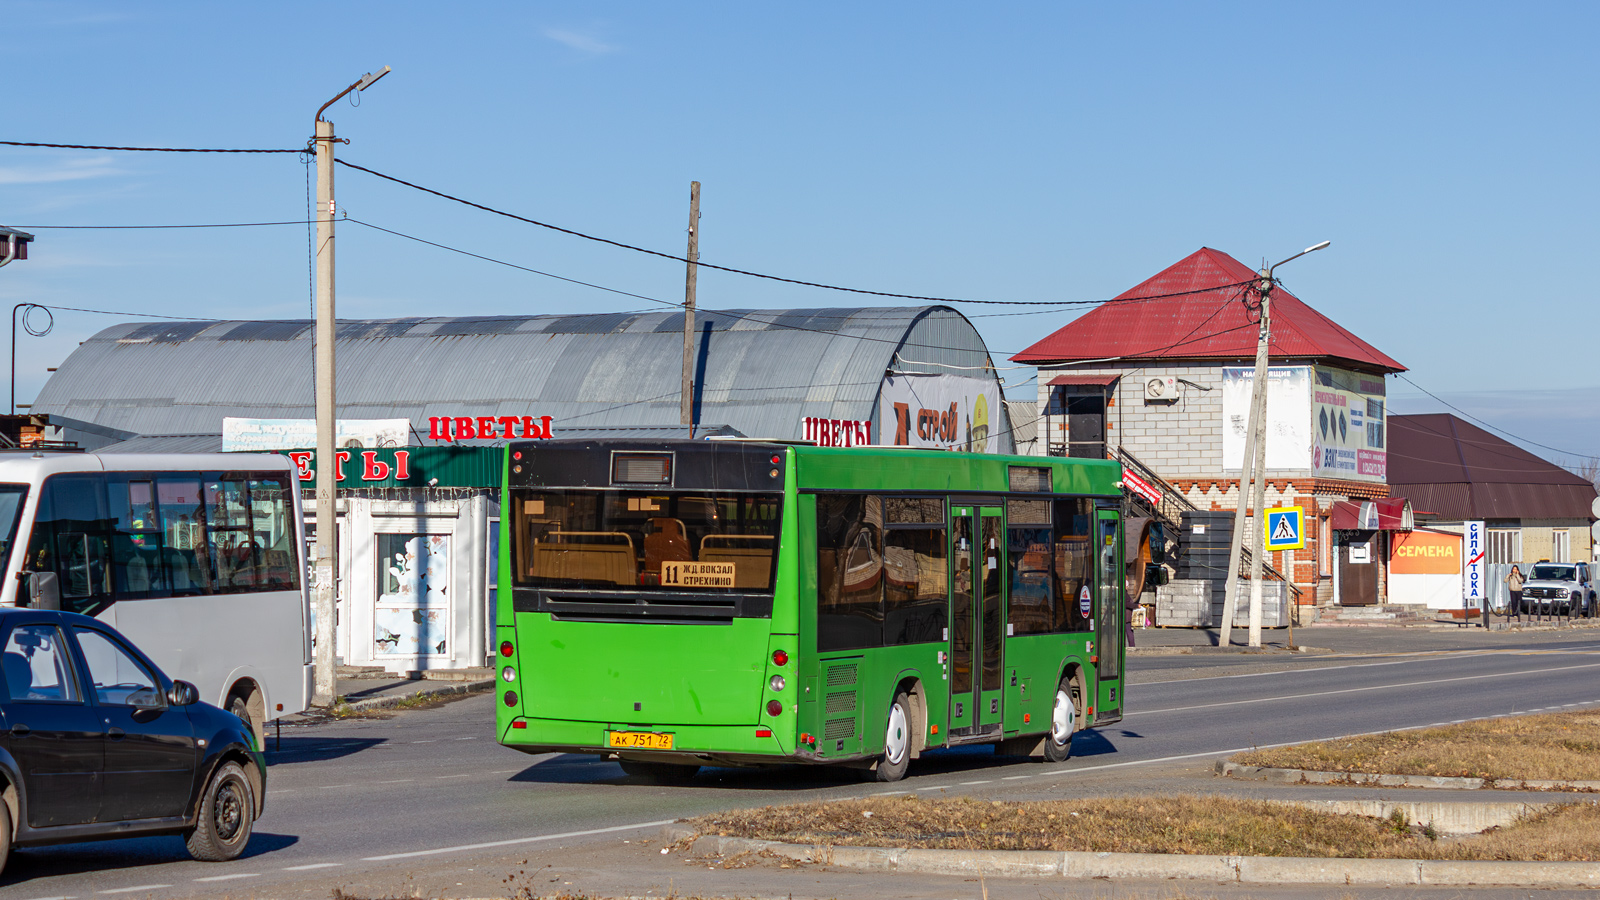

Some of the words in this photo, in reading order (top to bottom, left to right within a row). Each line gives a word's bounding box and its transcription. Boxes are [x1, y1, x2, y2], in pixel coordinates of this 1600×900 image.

[428, 415, 554, 443] ЦВЕТЫ
[801, 417, 871, 447] ЦВЕТЫ
[917, 401, 958, 443] СТРОЙ
[289, 450, 410, 481] ЕТЫ
[1397, 545, 1454, 557] СЕМЕНА
[1470, 523, 1478, 556] СИЛА
[665, 565, 678, 584] 11
[684, 576, 731, 586] СТРЕХНИНО
[700, 565, 733, 574] ВОКЗАЛ
[1470, 564, 1478, 597] ТОКА
[615, 736, 628, 745] АК
[633, 734, 652, 746] 751
[658, 735, 669, 744] 72
